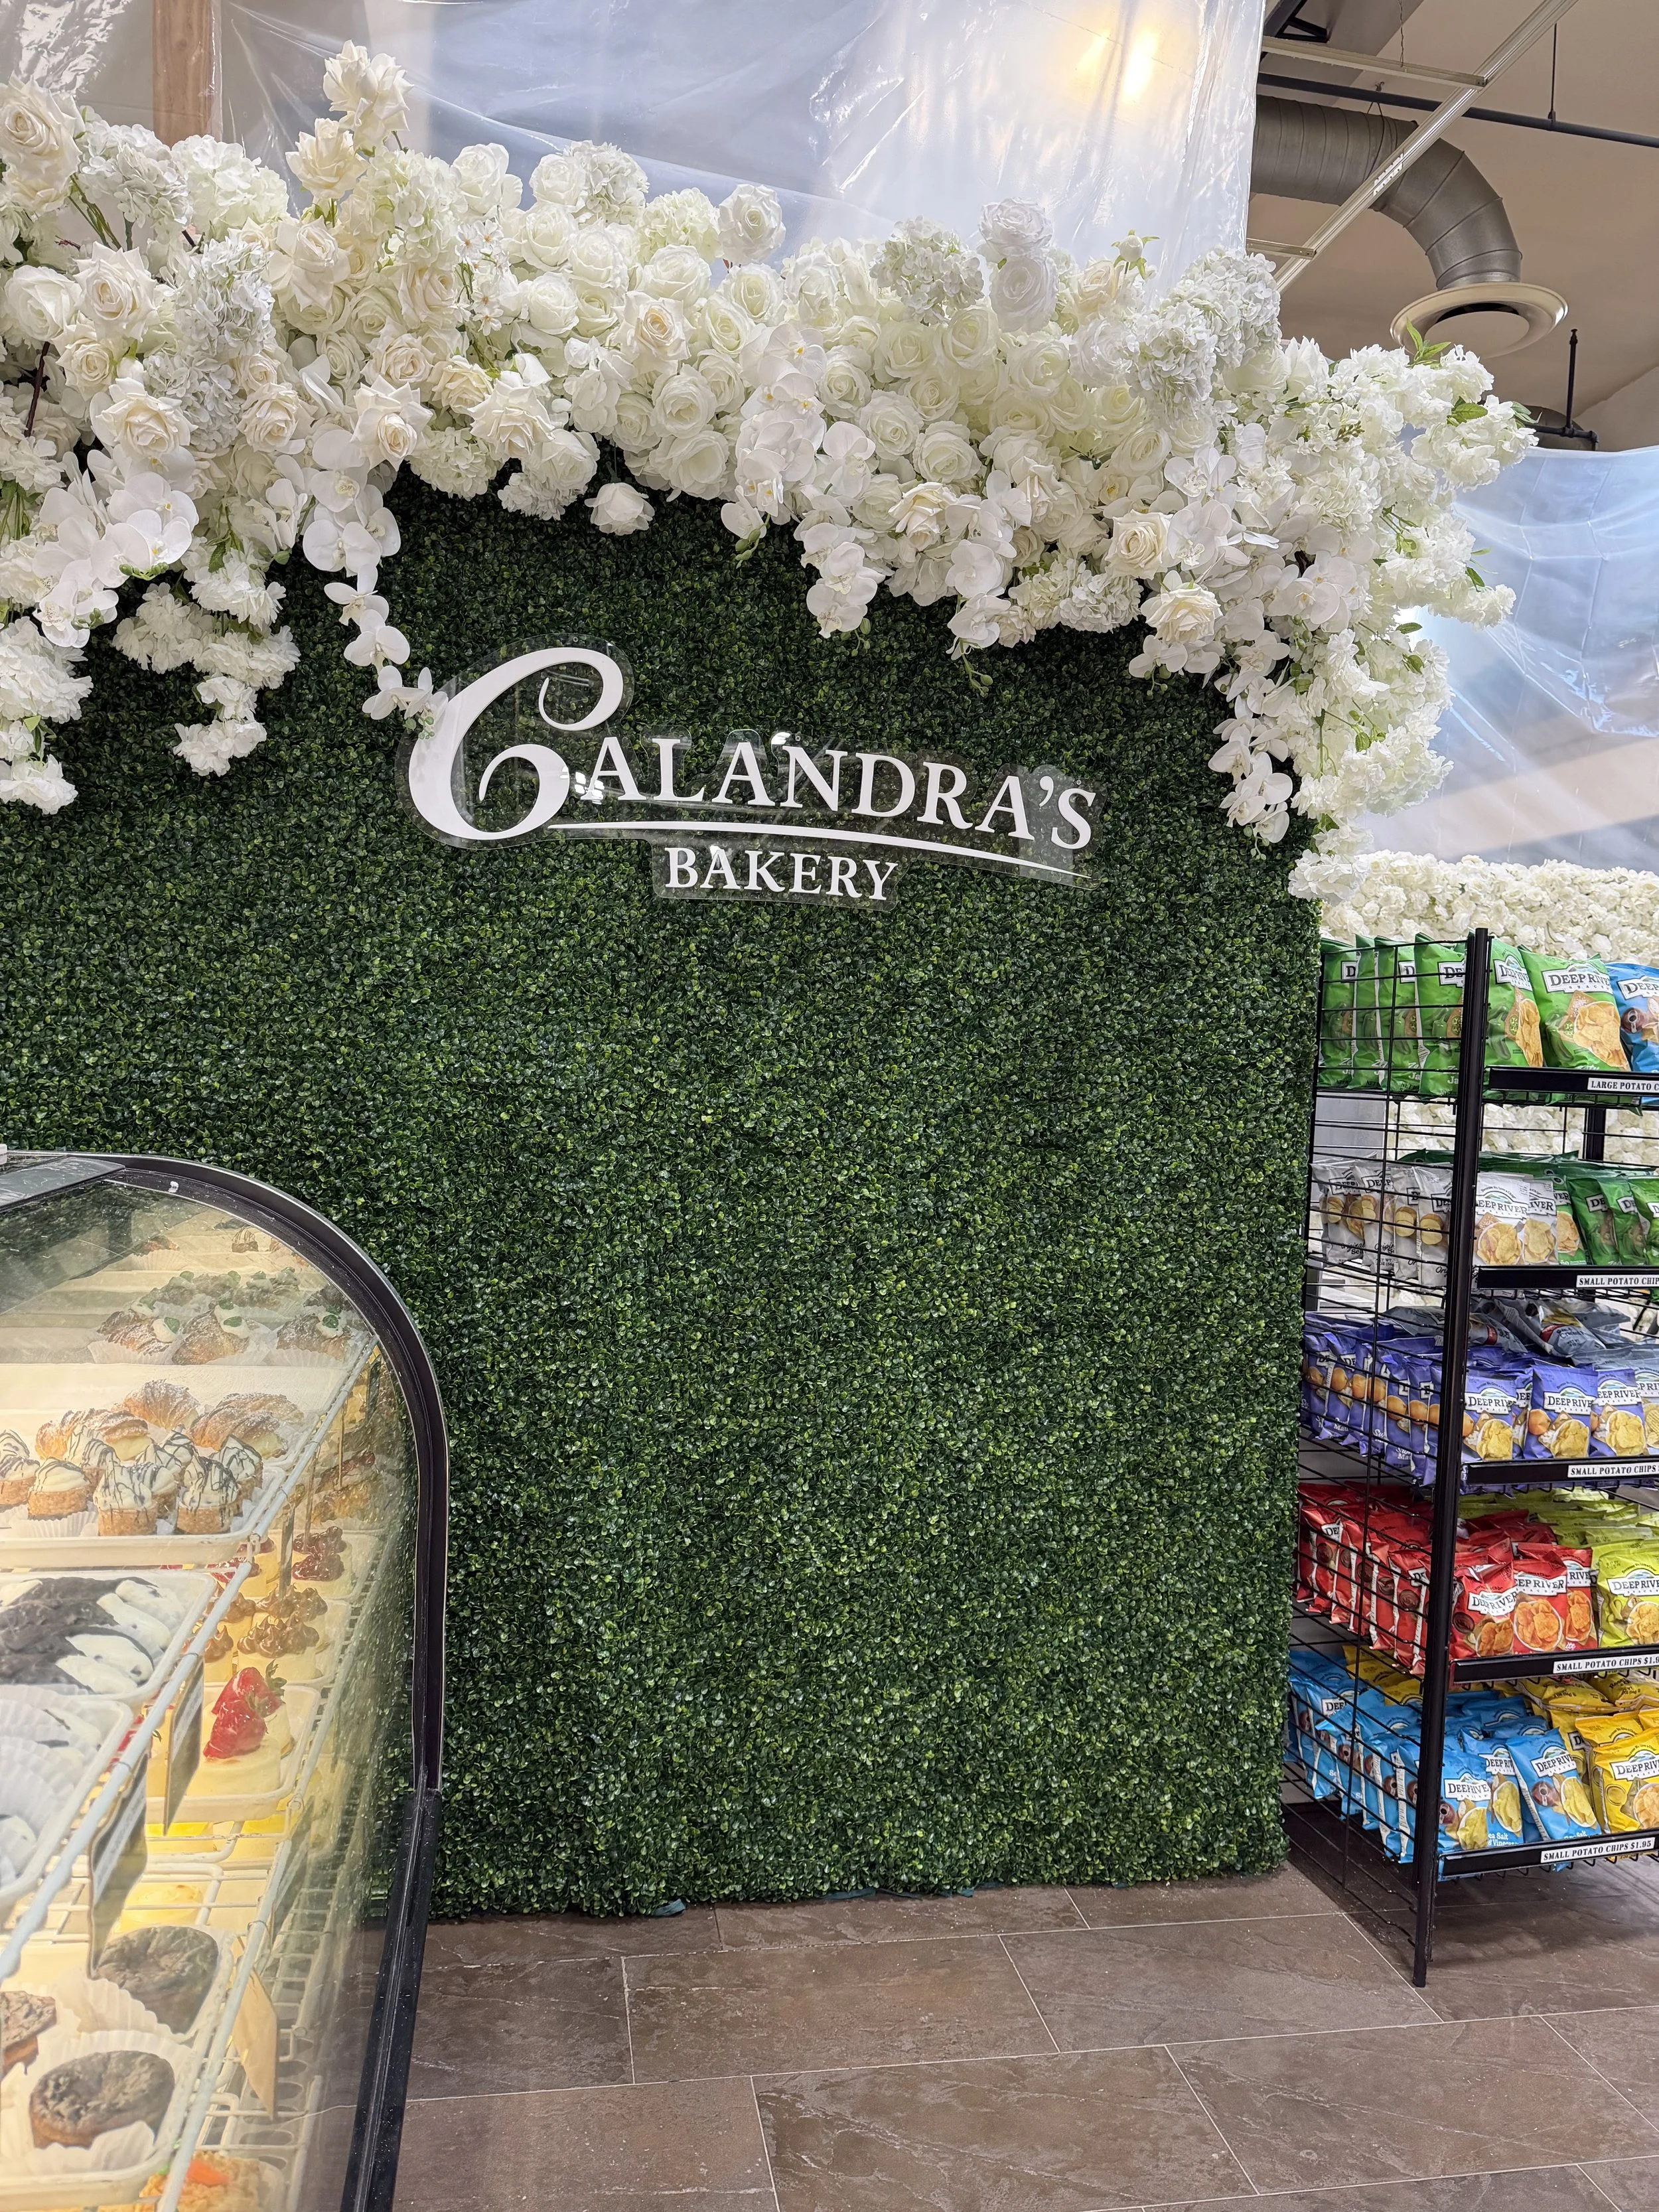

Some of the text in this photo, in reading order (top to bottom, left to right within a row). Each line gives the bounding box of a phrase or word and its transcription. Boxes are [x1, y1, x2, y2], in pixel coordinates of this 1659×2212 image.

[407, 646, 1097, 850] CALANDRA'S
[666, 847, 899, 901] BAKERY
[1548, 973, 1610, 986] DEEP RIVE
[1591, 1080, 1618, 1090] LARGE
[1620, 1082, 1652, 1090] POTATO
[1479, 1200, 1496, 1209] EEP
[1497, 1204, 1528, 1215] RIVER
[1529, 1201, 1553, 1211] IVER
[1579, 1277, 1605, 1286] SMALL
[1607, 1277, 1639, 1286] POTATO
[1469, 1396, 1493, 1406] DEEP
[1548, 1396, 1571, 1406] DEEP
[1572, 1398, 1592, 1408] RIVE
[1569, 1571, 1591, 1580] RIVE
[1533, 1580, 1564, 1588] RIVER
[1611, 1580, 1659, 1590] DEEP RIVE
[1585, 1659, 1617, 1668] POTATO
[1619, 1657, 1642, 1666] CHIPS
[1535, 1759, 1556, 1773] DEEP
[1616, 1763, 1643, 1775] DEEP
[1544, 1840, 1652, 1861] SMALL POTATO CHIPS $1.95
